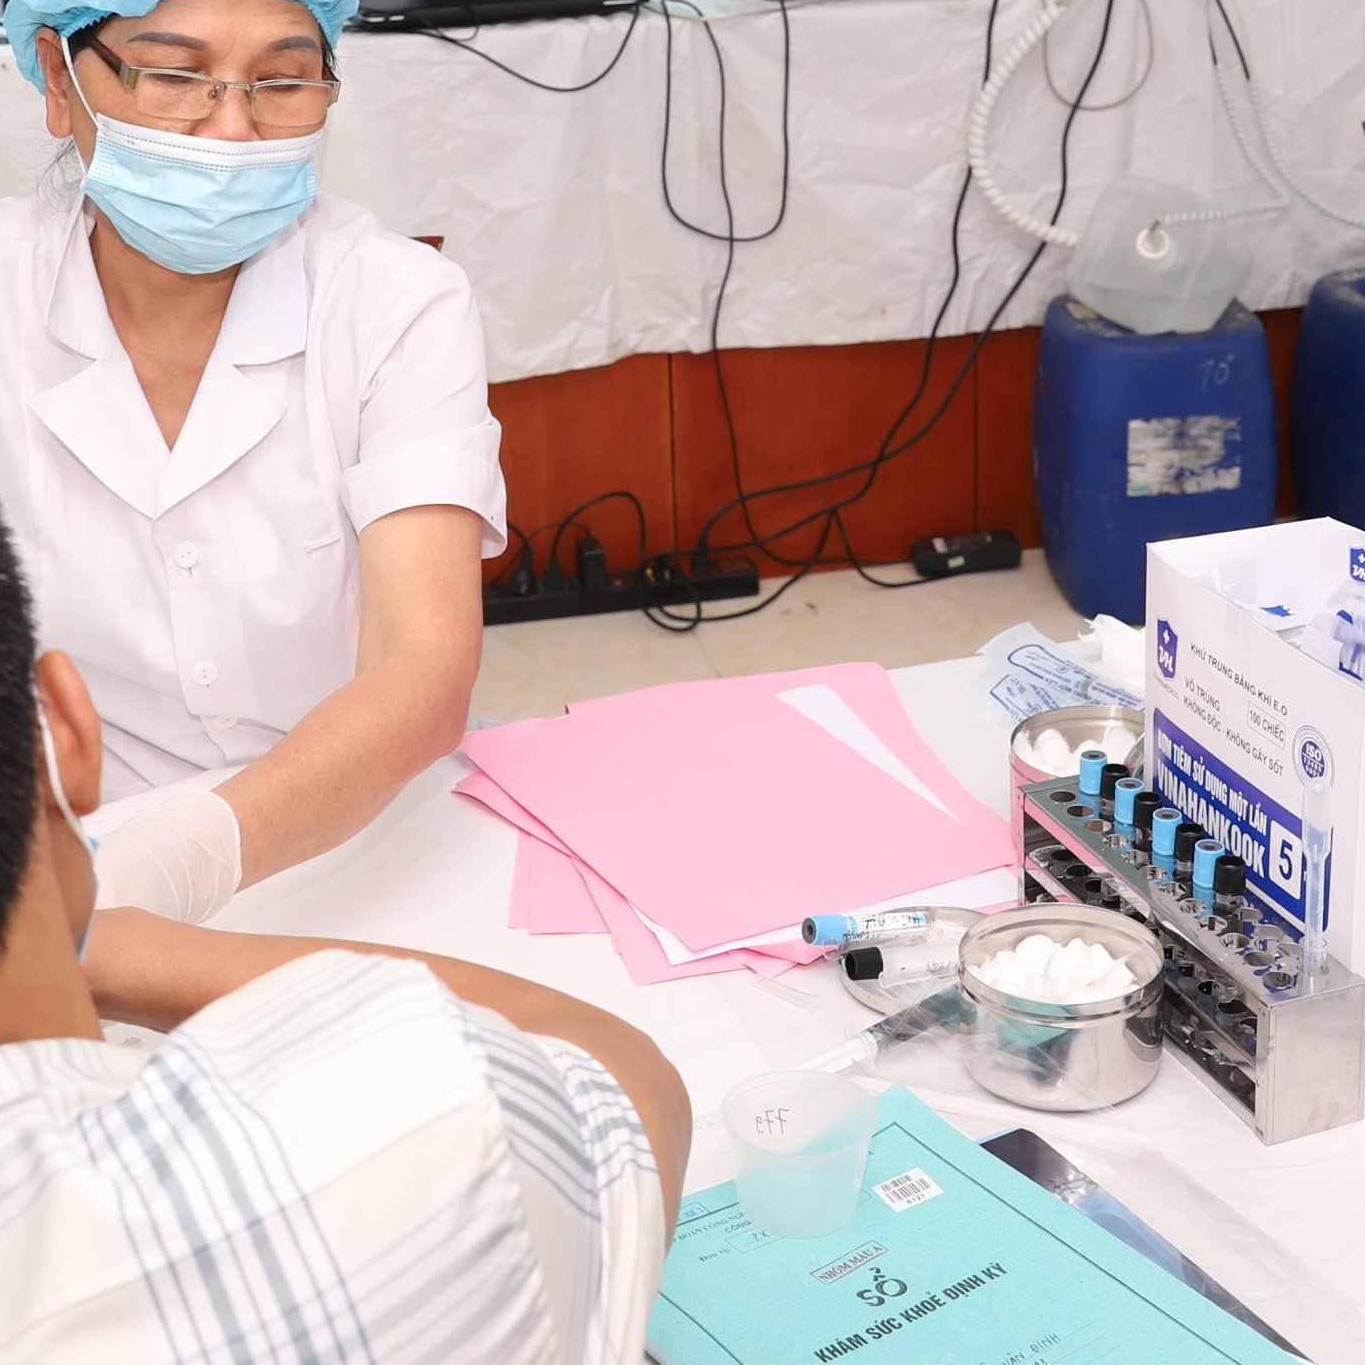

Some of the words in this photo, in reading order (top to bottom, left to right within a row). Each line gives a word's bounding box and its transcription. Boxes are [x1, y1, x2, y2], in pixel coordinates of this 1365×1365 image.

[1185, 677, 1195, 692] VÔ
[1196, 685, 1221, 711] TRÙNG
[1208, 654, 1233, 679] TRÙNG
[1258, 690, 1273, 707] KHÍ
[1273, 700, 1288, 716] E.O
[1184, 695, 1206, 721] KHÔNG
[1207, 712, 1222, 733] ĐỘC
[1226, 726, 1251, 755] KHÔNG
[1252, 744, 1268, 766] GÂY
[1268, 756, 1284, 777] SỐT
[1249, 709, 1261, 726] 100
[1262, 717, 1285, 742] CHIẾC
[1305, 742, 1322, 762] ISO
[1173, 744, 1191, 773] TIÊM
[1192, 756, 1205, 785] SỬ
[1205, 770, 1228, 803] DỤNG
[1229, 787, 1249, 822] MỘT
[1249, 801, 1268, 836] LẦN
[1157, 757, 1266, 879] VINAHANKOOK
[1278, 840, 1293, 881] 5
[906, 1193, 925, 1205] 6121
[818, 1260, 849, 1282] NHÓM
[851, 1250, 873, 1266] MÁU
[873, 1245, 884, 1254] A
[856, 1266, 908, 1307] SỔ
[813, 1332, 869, 1364] KHÁM
[865, 1316, 903, 1341] SỨC
[899, 1290, 947, 1323] KHOẺ
[944, 1274, 986, 1301] ĐỊNH
[980, 1261, 1008, 1281] KỲ
